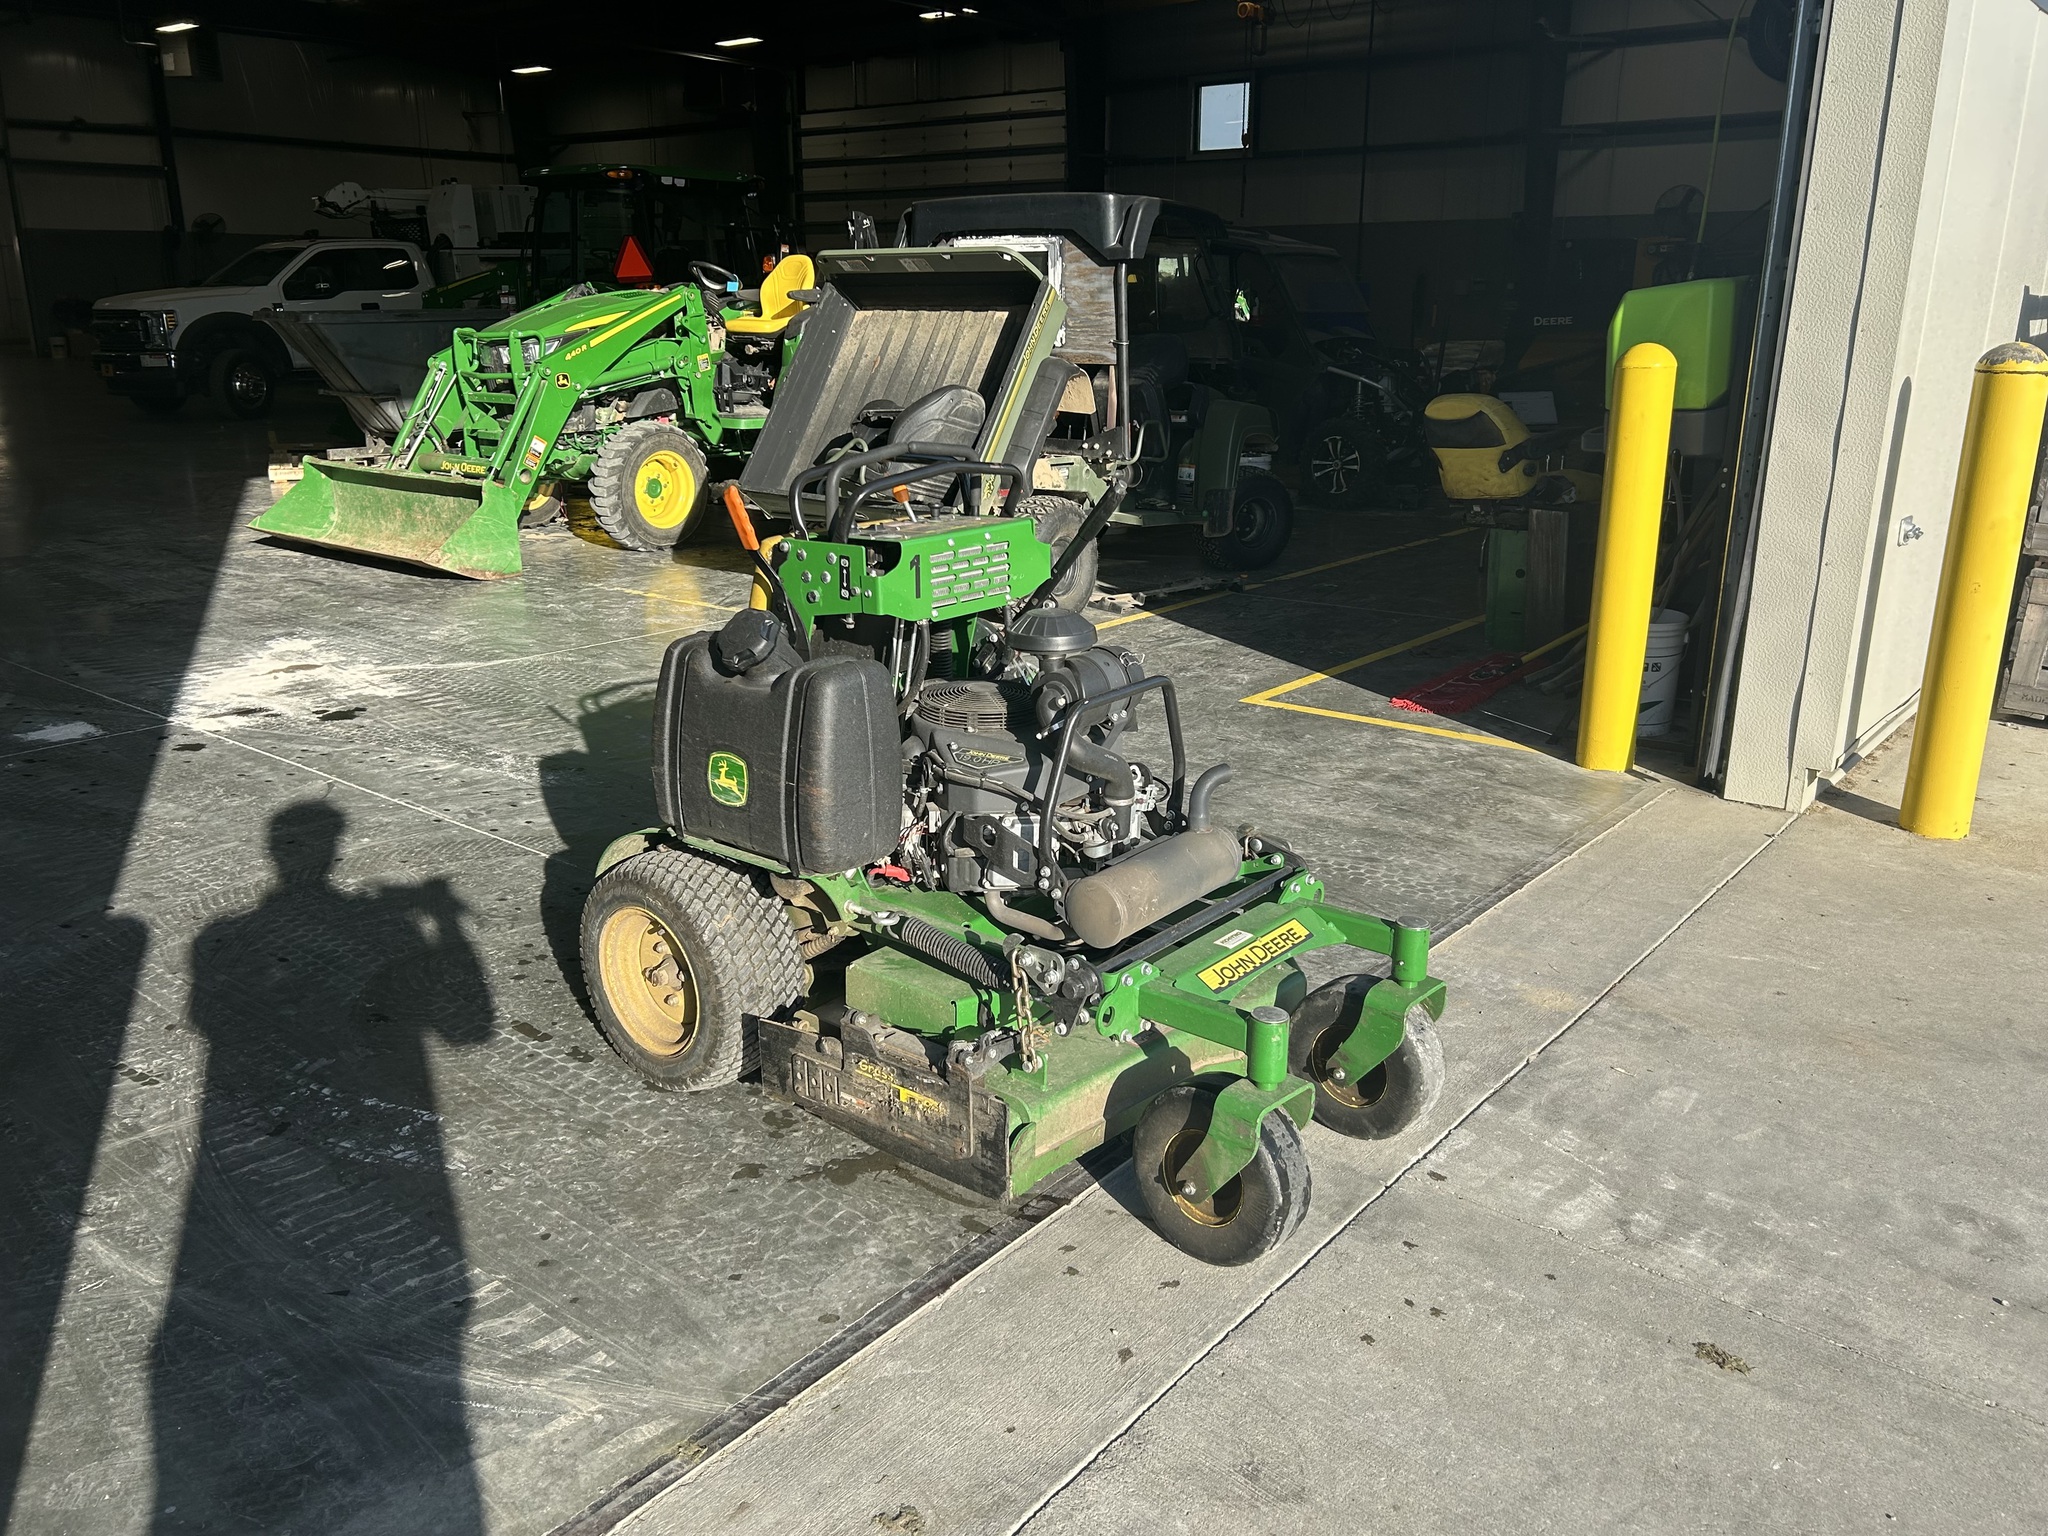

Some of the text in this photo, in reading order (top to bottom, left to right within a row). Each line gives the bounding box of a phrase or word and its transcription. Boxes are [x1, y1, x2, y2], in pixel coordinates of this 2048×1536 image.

[1533, 316, 1573, 326] DEERE
[461, 462, 487, 475] DEERE
[909, 554, 921, 599] 1
[1212, 927, 1303, 986] JOHN DEERE
